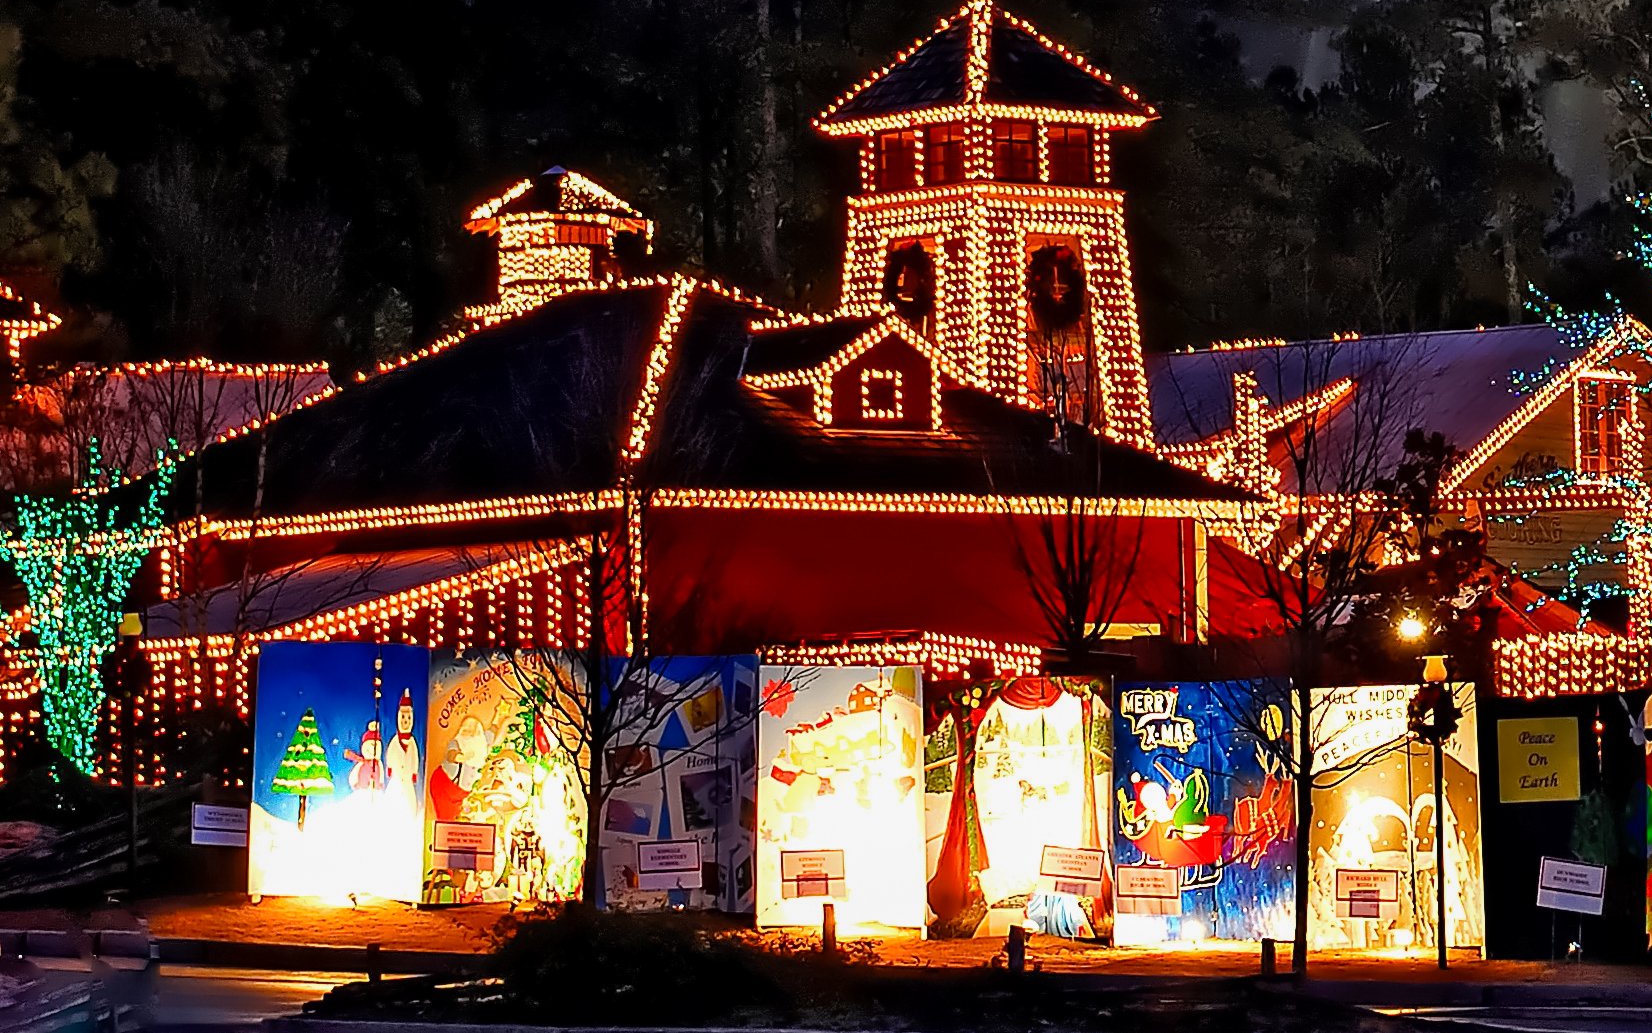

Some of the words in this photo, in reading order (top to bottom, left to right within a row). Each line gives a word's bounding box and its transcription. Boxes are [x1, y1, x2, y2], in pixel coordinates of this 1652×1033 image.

[438, 688, 466, 729] COME
[1122, 690, 1178, 715] MERRY
[1346, 708, 1403, 721] WISHES
[1519, 731, 1555, 744] Peace
[1528, 753, 1548, 766] On
[1519, 772, 1558, 789] Earth
